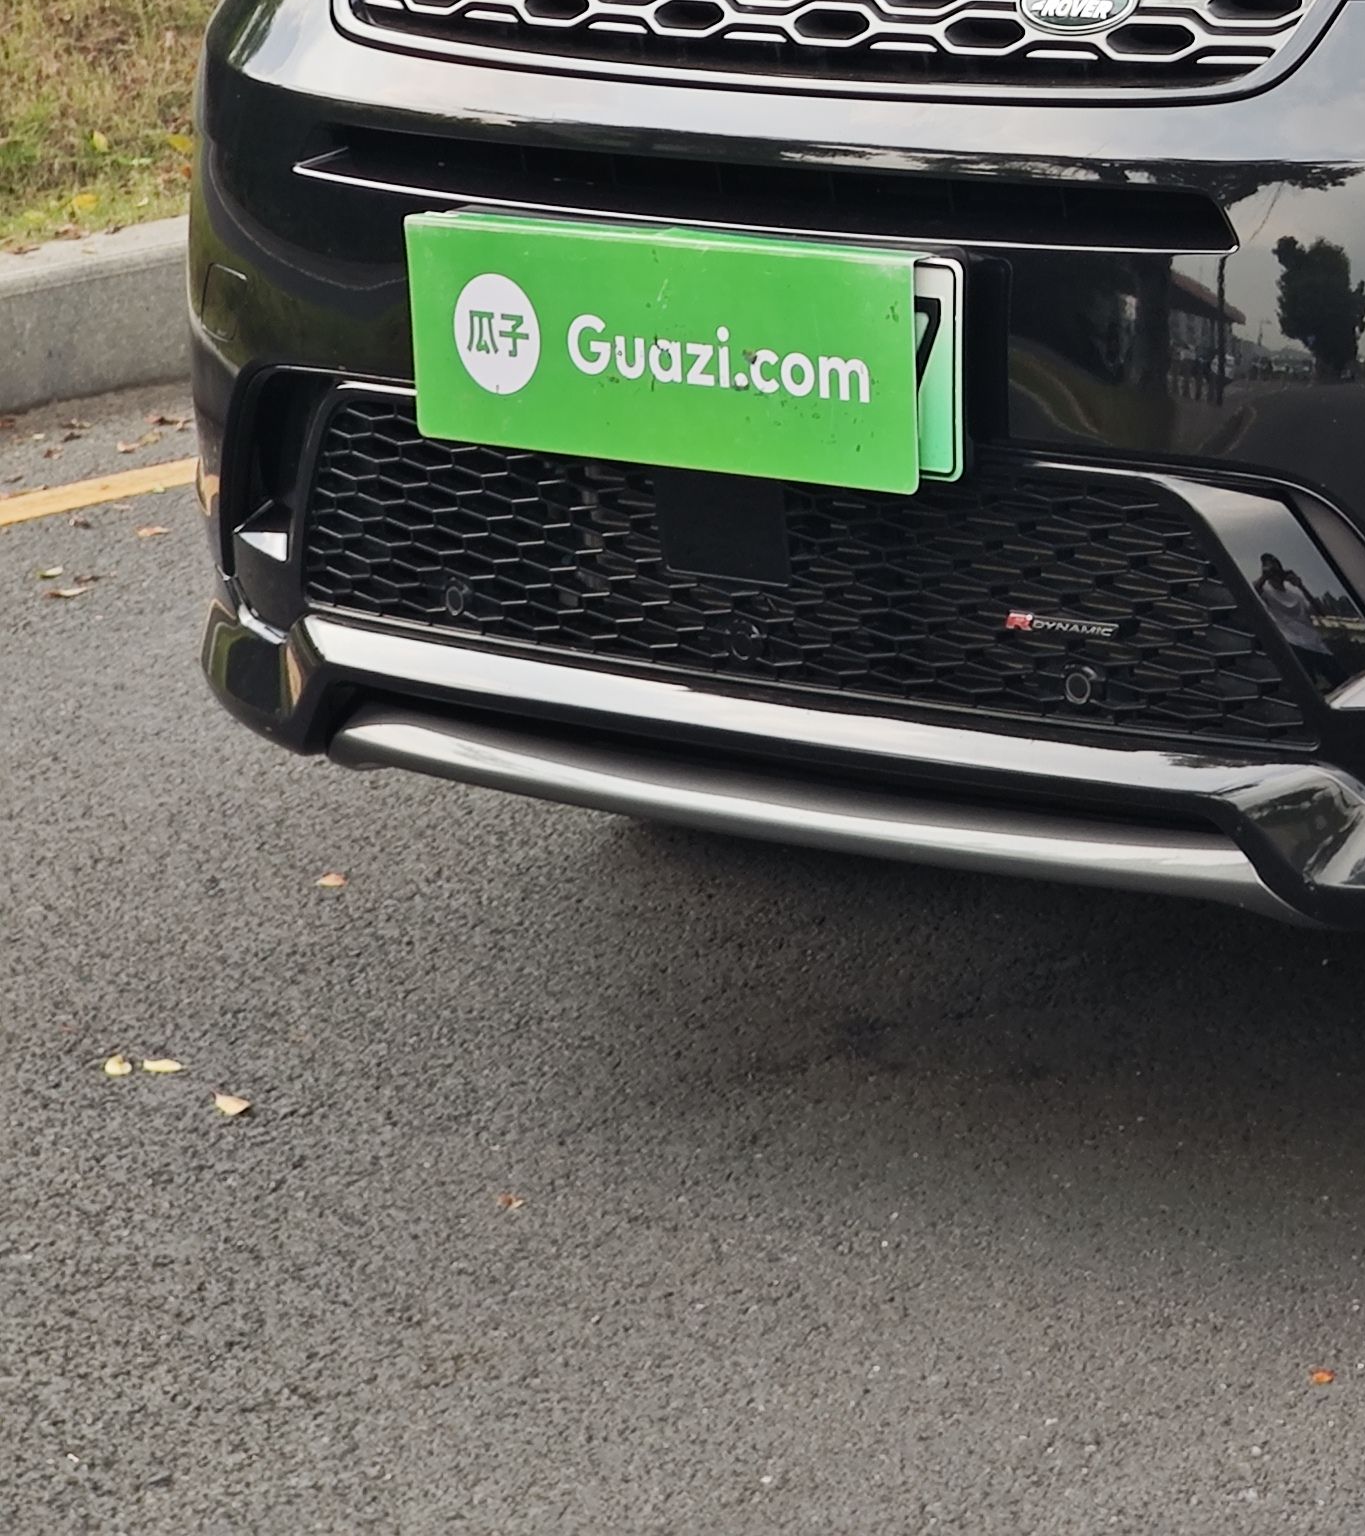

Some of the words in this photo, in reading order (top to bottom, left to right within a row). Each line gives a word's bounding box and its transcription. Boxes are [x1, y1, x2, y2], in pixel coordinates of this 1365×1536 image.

[466, 310, 529, 357] 瓜子
[567, 313, 871, 403] Guazi.com
[1032, 619, 1114, 636] DYNAMIC
